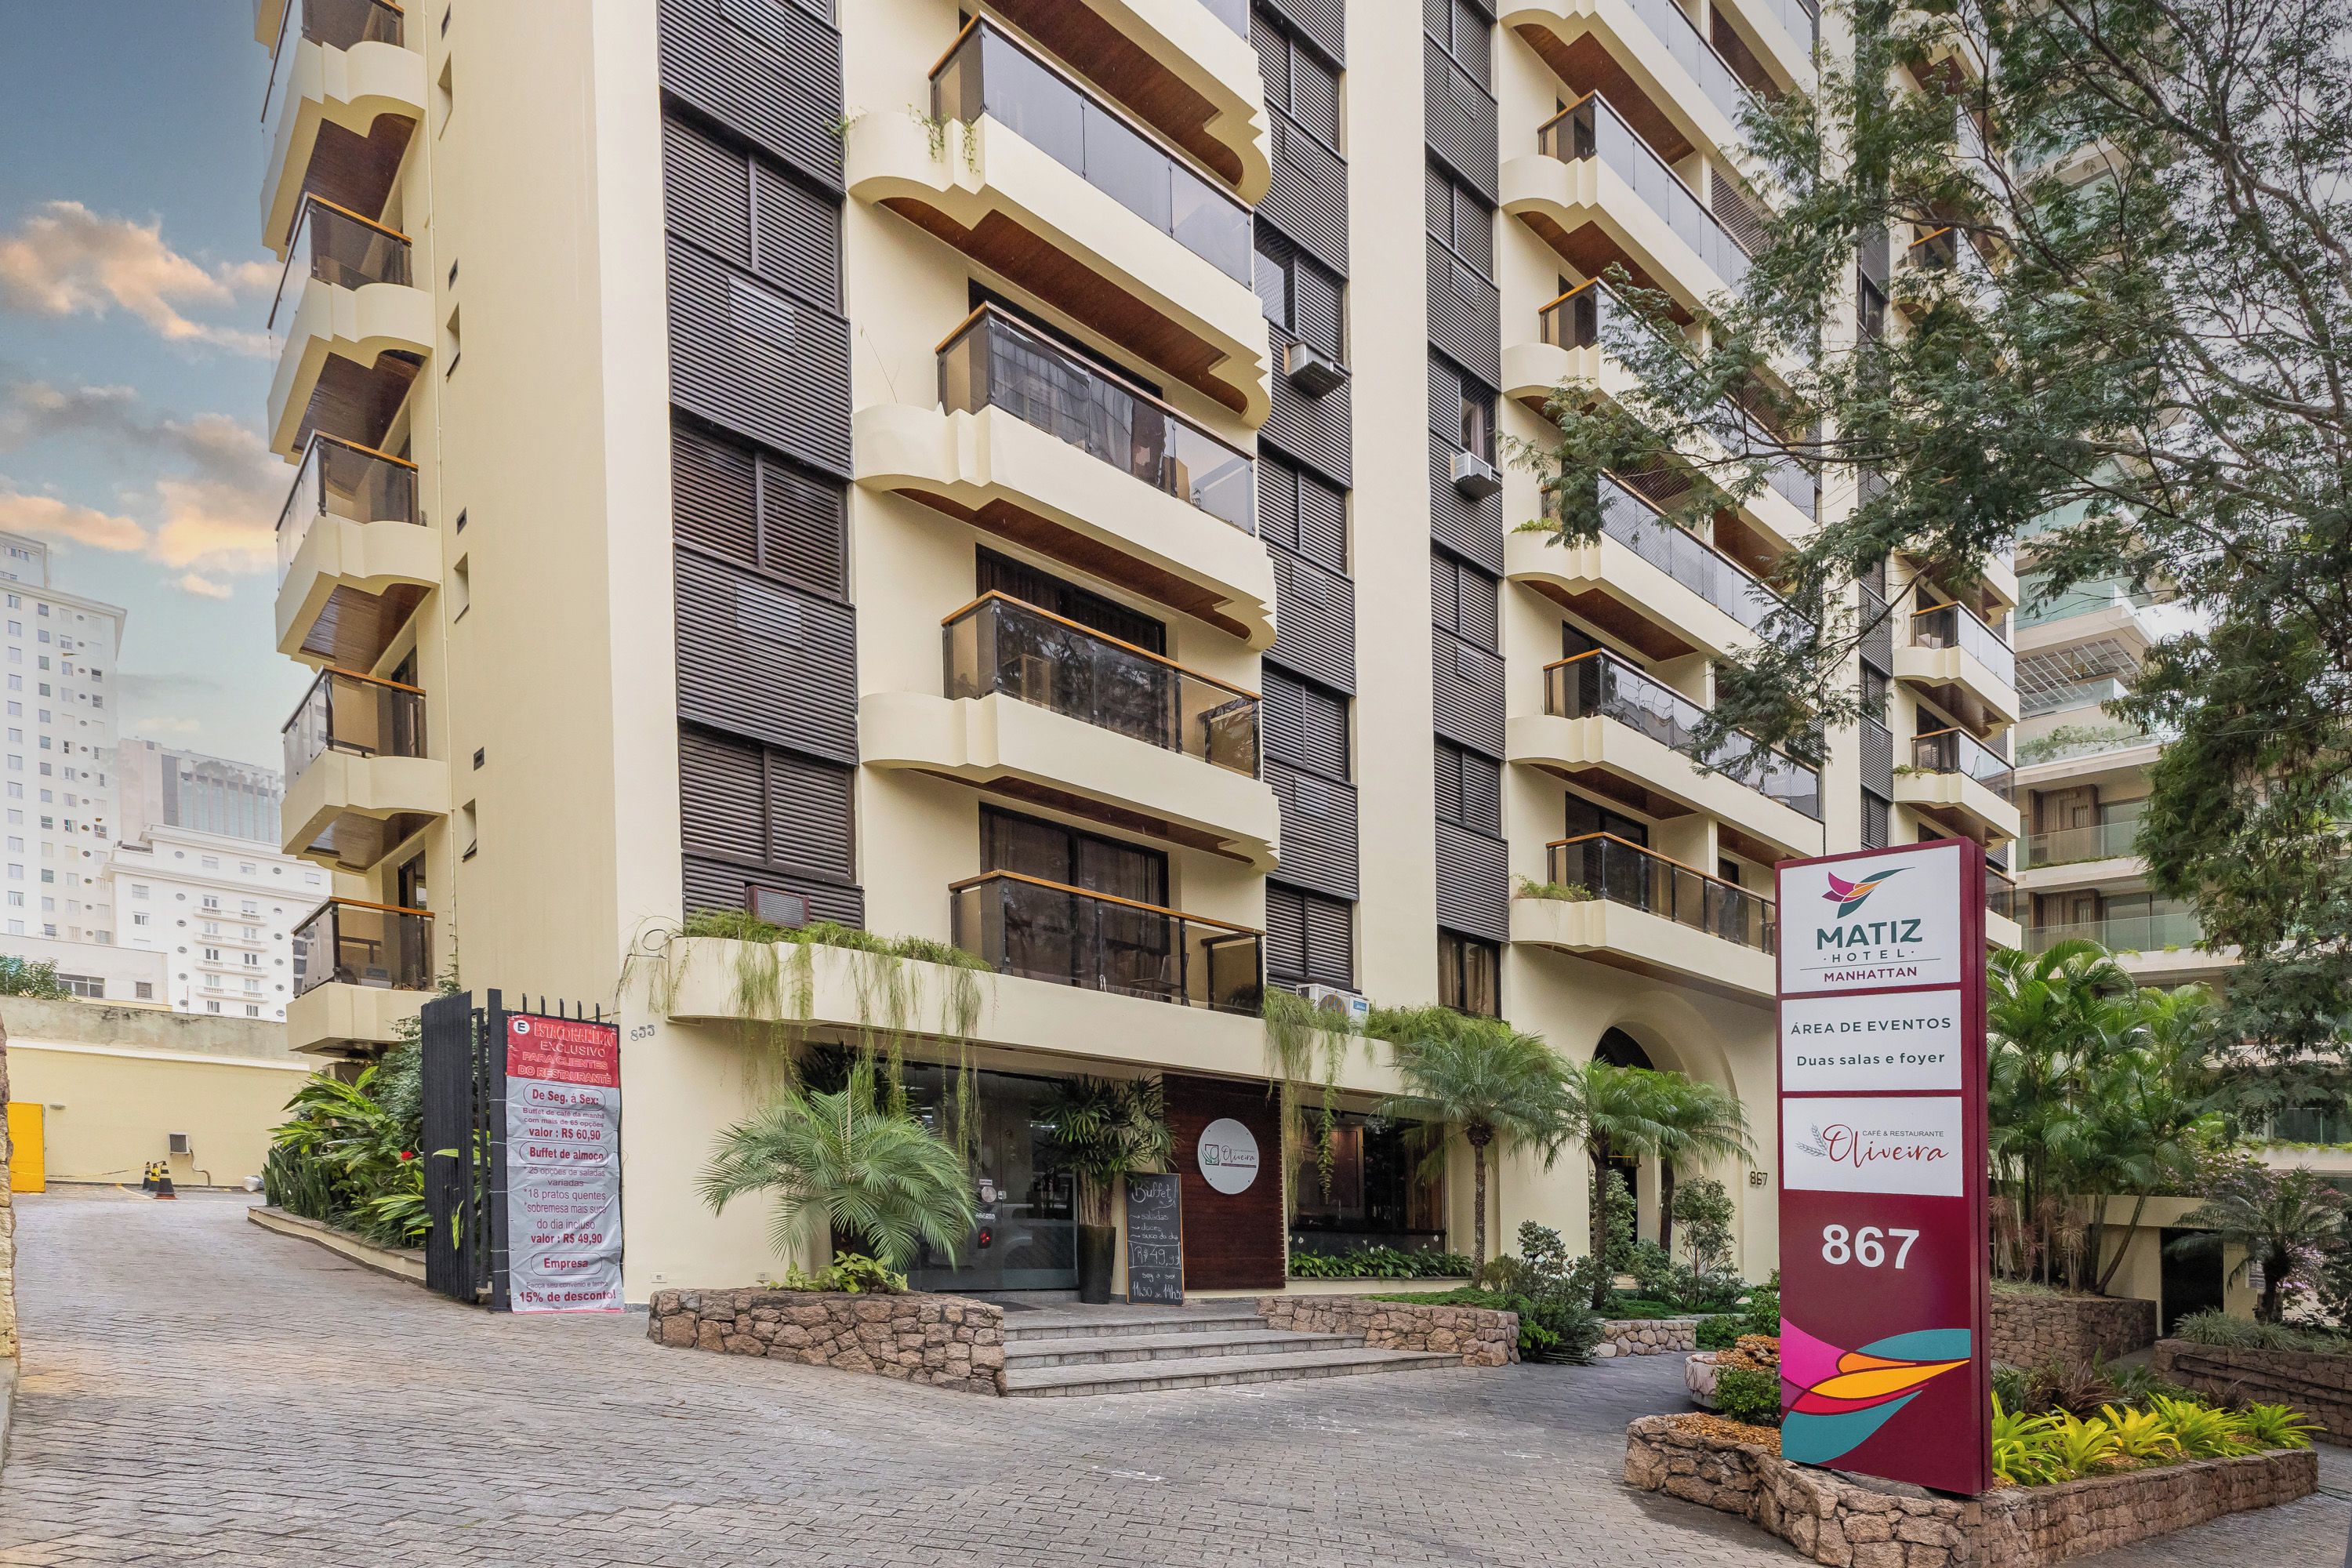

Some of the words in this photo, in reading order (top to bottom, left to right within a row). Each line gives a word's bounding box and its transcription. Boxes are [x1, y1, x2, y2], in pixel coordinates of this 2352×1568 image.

[1817, 918, 1923, 950] MATIZ
[1832, 949, 1905, 963] HOTEL
[1824, 967, 1917, 982] MANHATTAN
[517, 1022, 526, 1032] E
[630, 1024, 655, 1041] 855
[1791, 1022, 1835, 1035] ÁREA
[1840, 1022, 1862, 1033] DE
[1867, 1018, 1951, 1032] EVENTOS
[540, 1040, 605, 1057] EXCLUSIVO
[523, 1051, 555, 1064] PARA
[555, 1056, 608, 1070] CLIENTES
[1797, 1056, 1835, 1066] Duas
[1839, 1054, 1881, 1065] salas
[1886, 1055, 1894, 1064] e
[1899, 1052, 1945, 1065] foyer
[517, 1065, 535, 1076] DO
[536, 1067, 612, 1084] RESTAURANTE
[532, 1089, 545, 1100] De
[547, 1091, 568, 1105] Seg.
[579, 1094, 599, 1105] Sex:
[529, 1127, 553, 1138] valor
[561, 1127, 573, 1139] R$
[576, 1130, 601, 1142] 60,90
[530, 1146, 557, 1159] Buffet
[560, 1150, 570, 1159] de
[1823, 1123, 1949, 1168] Oliveira
[1221, 1145, 1255, 1163] Oliveira
[539, 1167, 566, 1176] opções
[1750, 1171, 1768, 1185] 867
[542, 1189, 570, 1200] pratos
[572, 1190, 606, 1201] quentes
[571, 1204, 588, 1214] mais
[1141, 1210, 1169, 1221] saladas
[537, 1219, 548, 1229] do
[550, 1219, 564, 1229] dia
[565, 1219, 596, 1229] incluso
[531, 1233, 554, 1243] valor
[563, 1233, 575, 1244] R$
[578, 1233, 602, 1245] 49,90
[1822, 1224, 1920, 1269] 867
[543, 1258, 589, 1270] Empresa
[519, 1291, 543, 1302] 15%
[547, 1292, 561, 1301] de
[564, 1289, 616, 1301] desconto!
